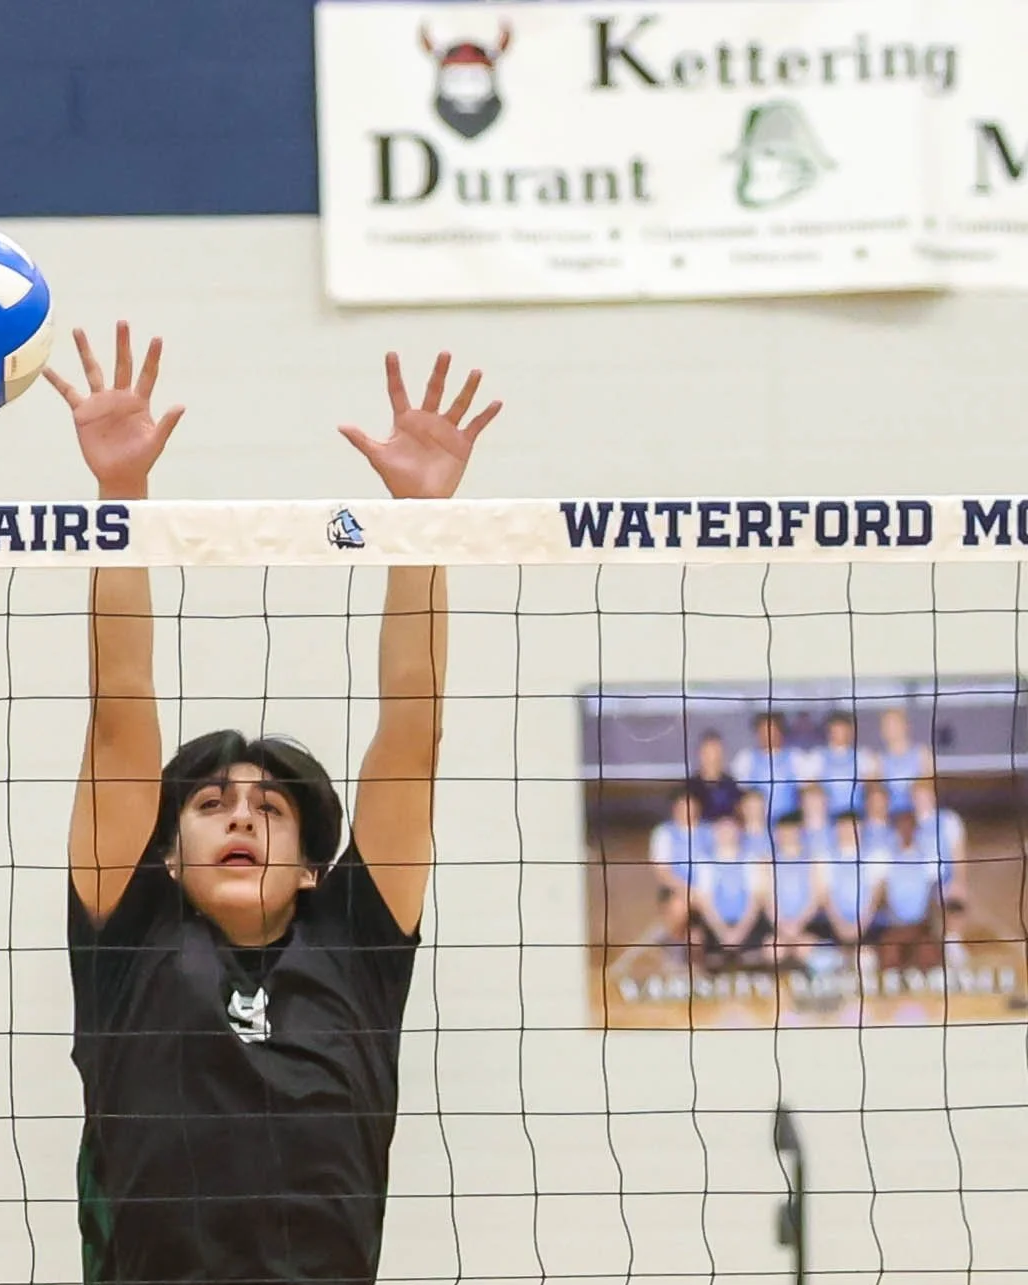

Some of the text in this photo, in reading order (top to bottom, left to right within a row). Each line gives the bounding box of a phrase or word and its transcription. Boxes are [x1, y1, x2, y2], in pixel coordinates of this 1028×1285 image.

[589, 14, 960, 91] Kettering
[369, 131, 655, 207] Durant
[559, 500, 934, 548] WATERFORD
